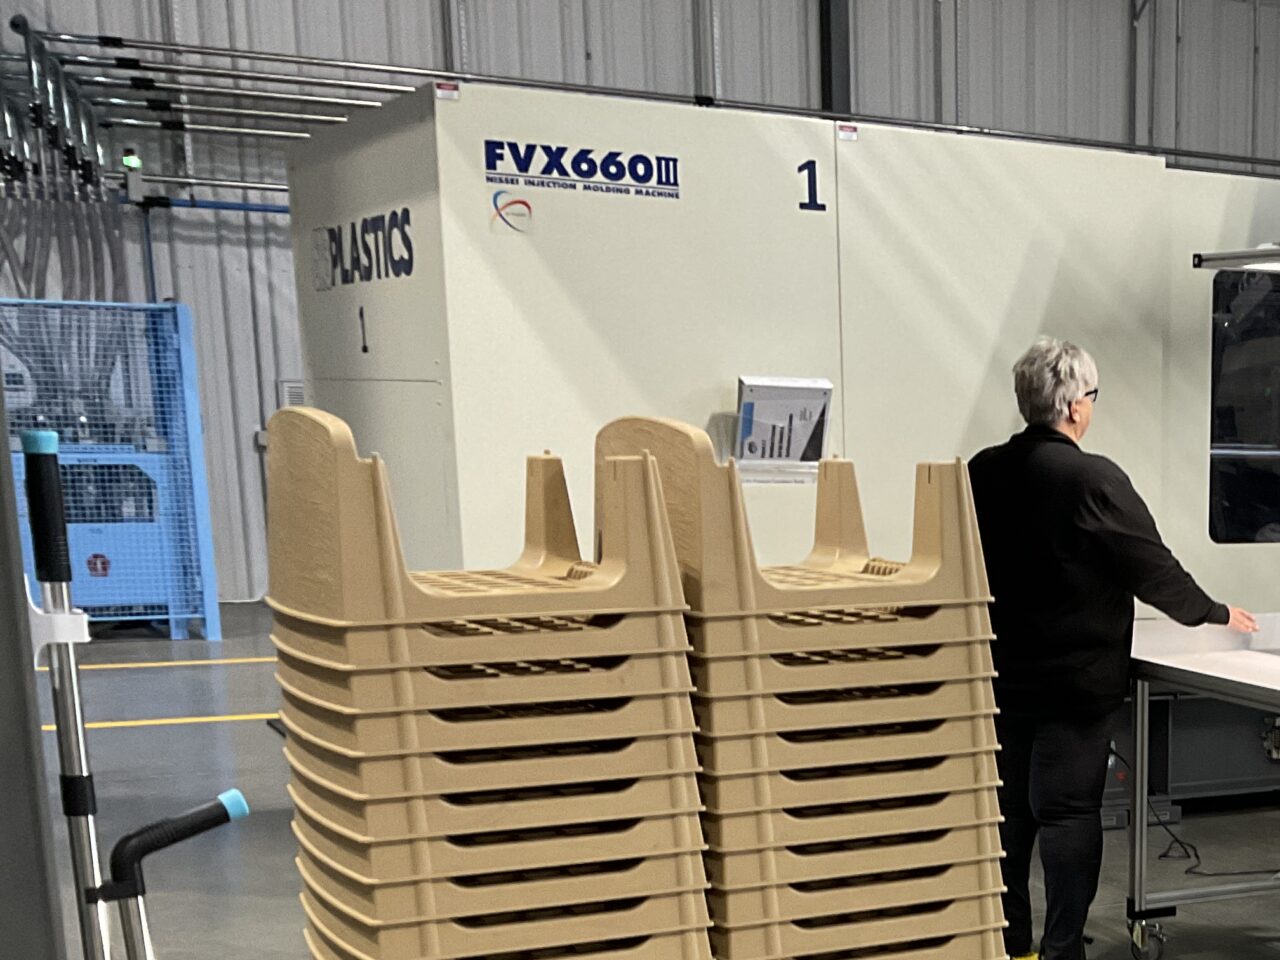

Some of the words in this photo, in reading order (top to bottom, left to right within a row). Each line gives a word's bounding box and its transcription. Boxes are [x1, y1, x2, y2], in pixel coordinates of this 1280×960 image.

[485, 175, 519, 186] NISSEI
[524, 179, 577, 191] INJECTION
[582, 183, 631, 195] MOLDING
[635, 187, 680, 200] MACHINE
[797, 159, 827, 211] 1
[327, 207, 414, 287] PLASTICS
[358, 305, 369, 354] 1
